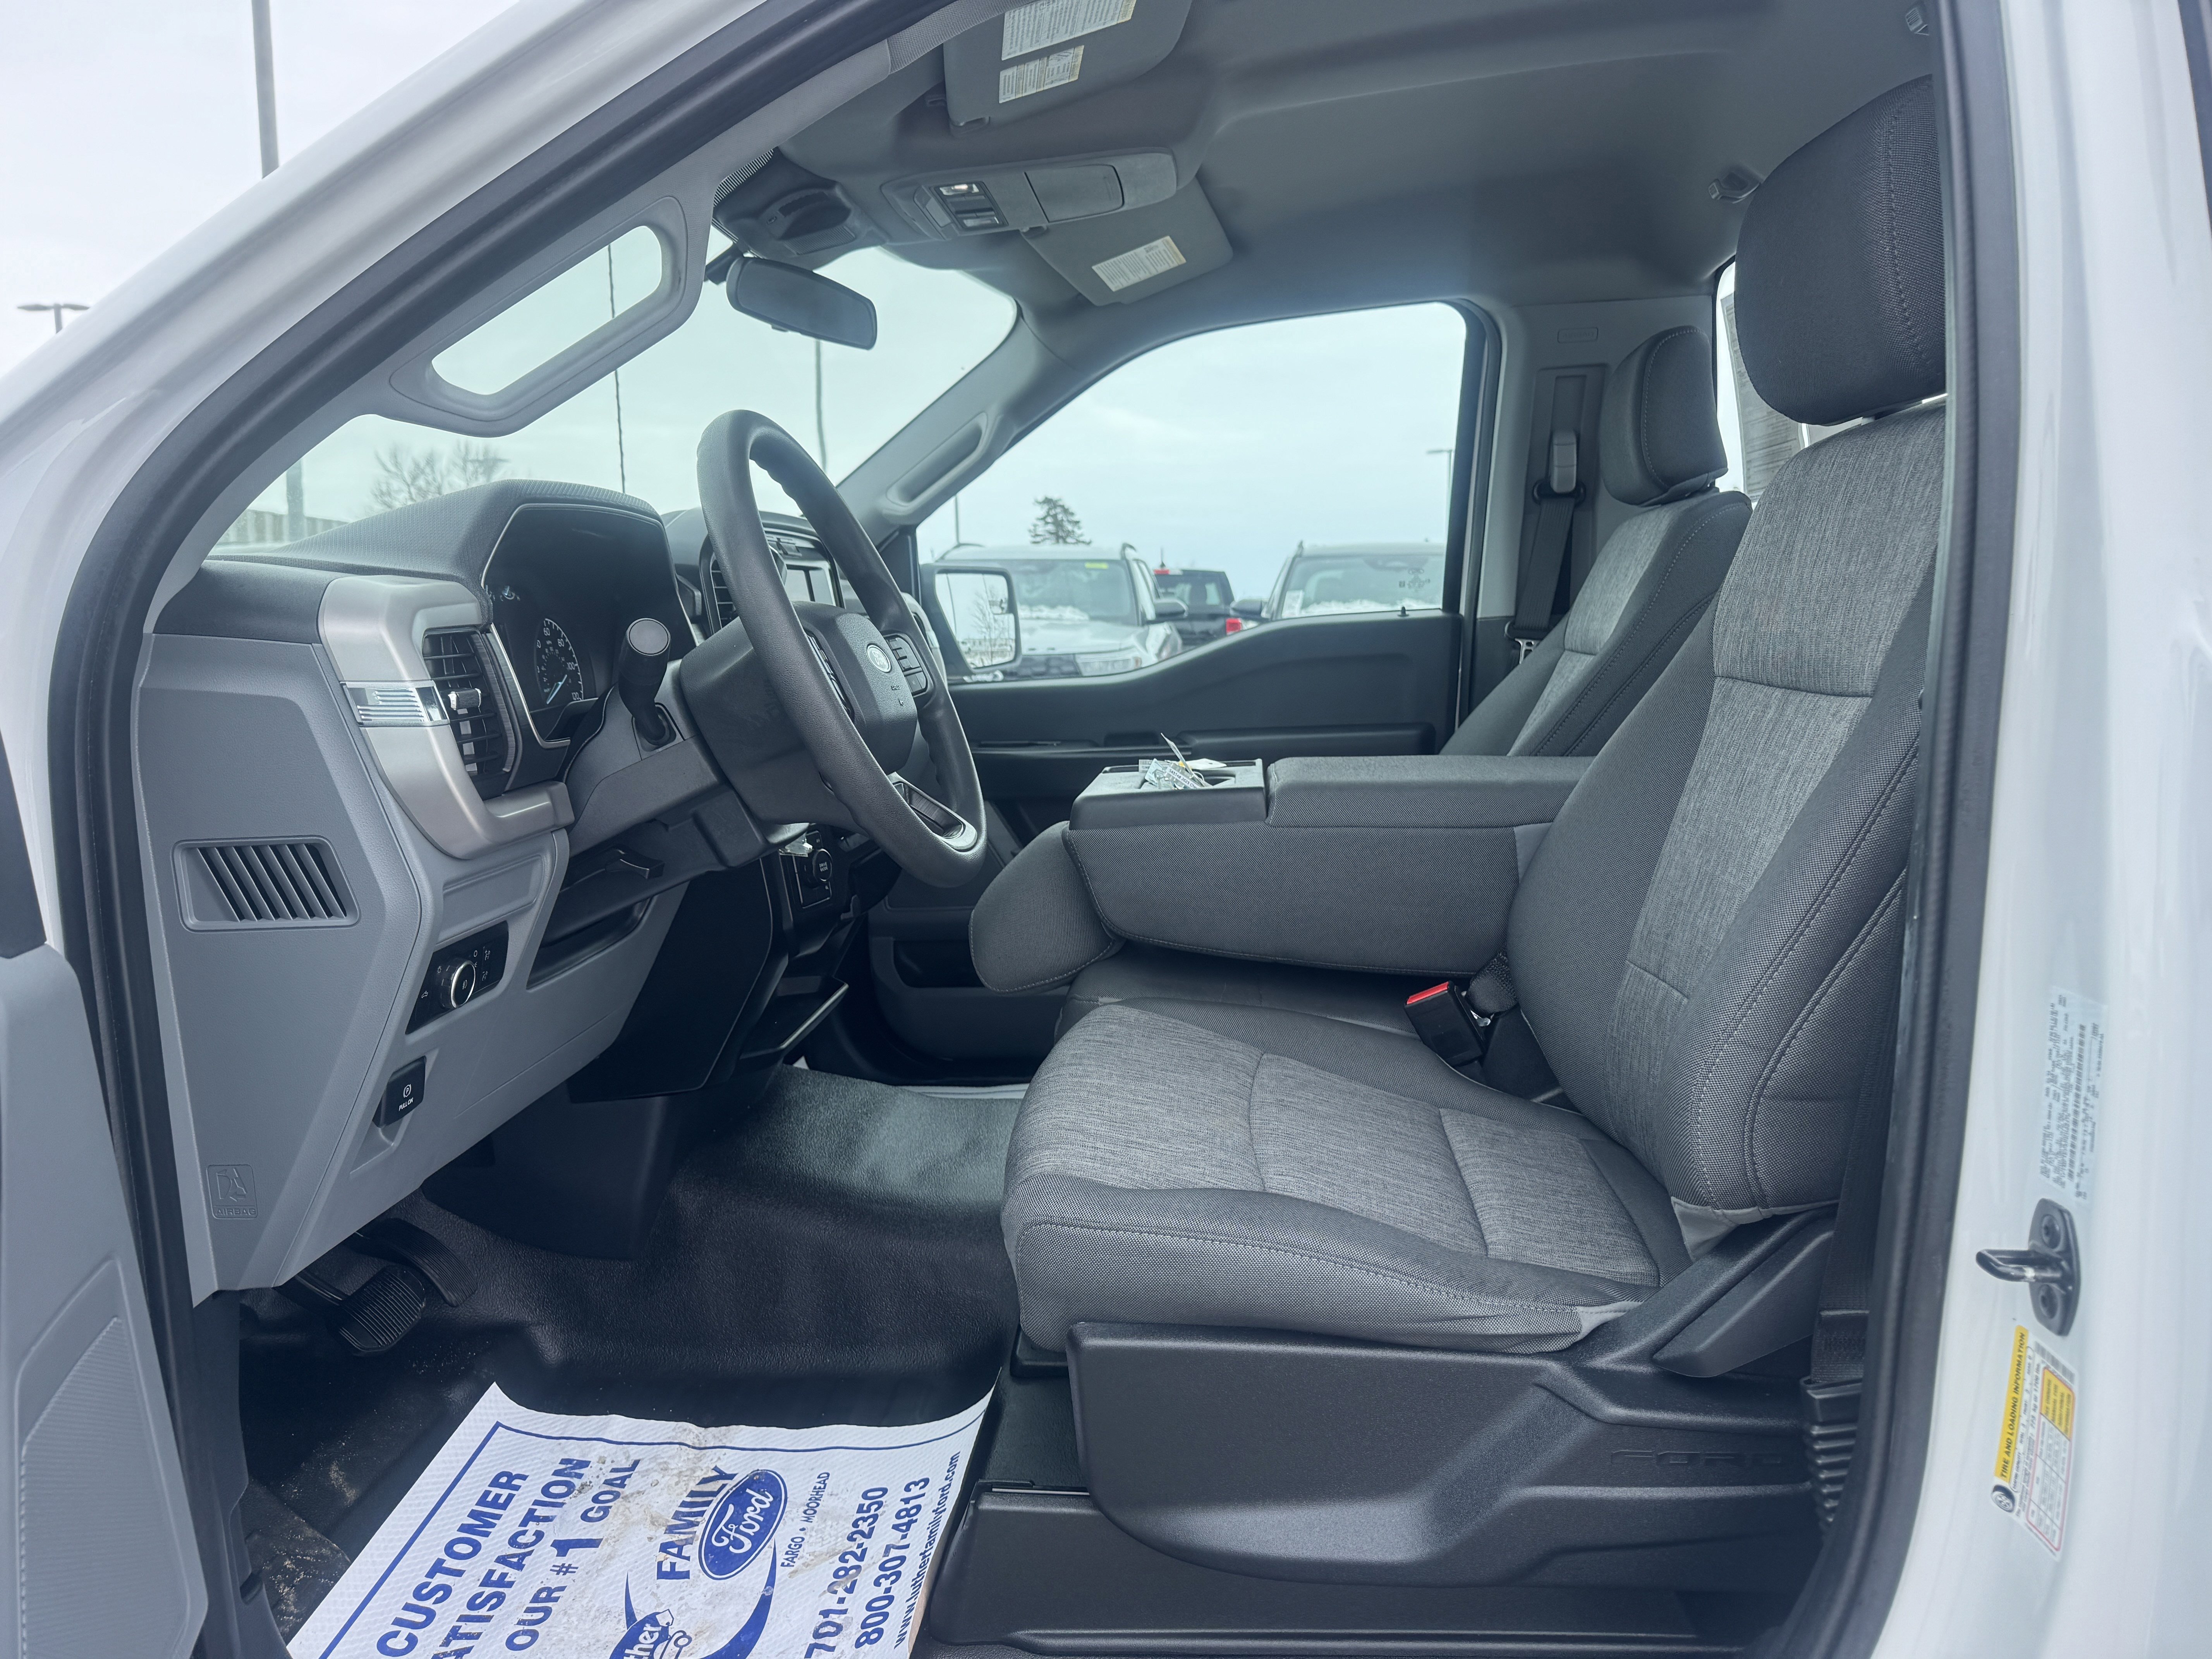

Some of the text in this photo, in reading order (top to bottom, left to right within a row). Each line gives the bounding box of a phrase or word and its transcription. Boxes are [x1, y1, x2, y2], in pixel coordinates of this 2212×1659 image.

[544, 627, 550, 636] 60
[557, 639, 564, 647] 80
[567, 662, 575, 670] 100
[399, 1097, 414, 1111] PULL ON
[2000, 1332, 2025, 1479] TIRE AND LOADING INFORMATION
[376, 1470, 529, 1657] CUSTOMER
[431, 1458, 591, 1659] ATISFACTION
[505, 1585, 568, 1651] OUR
[580, 1459, 641, 1523] GOAL
[656, 1465, 739, 1580] FAMILY
[711, 1488, 774, 1554] Ford
[781, 1472, 830, 1567] FARGO MOORHEAD
[804, 1487, 888, 1659] 701-282-2350
[854, 1477, 930, 1649] 800-307-4813
[894, 1451, 960, 1650] www.lutherfamilyford.com
